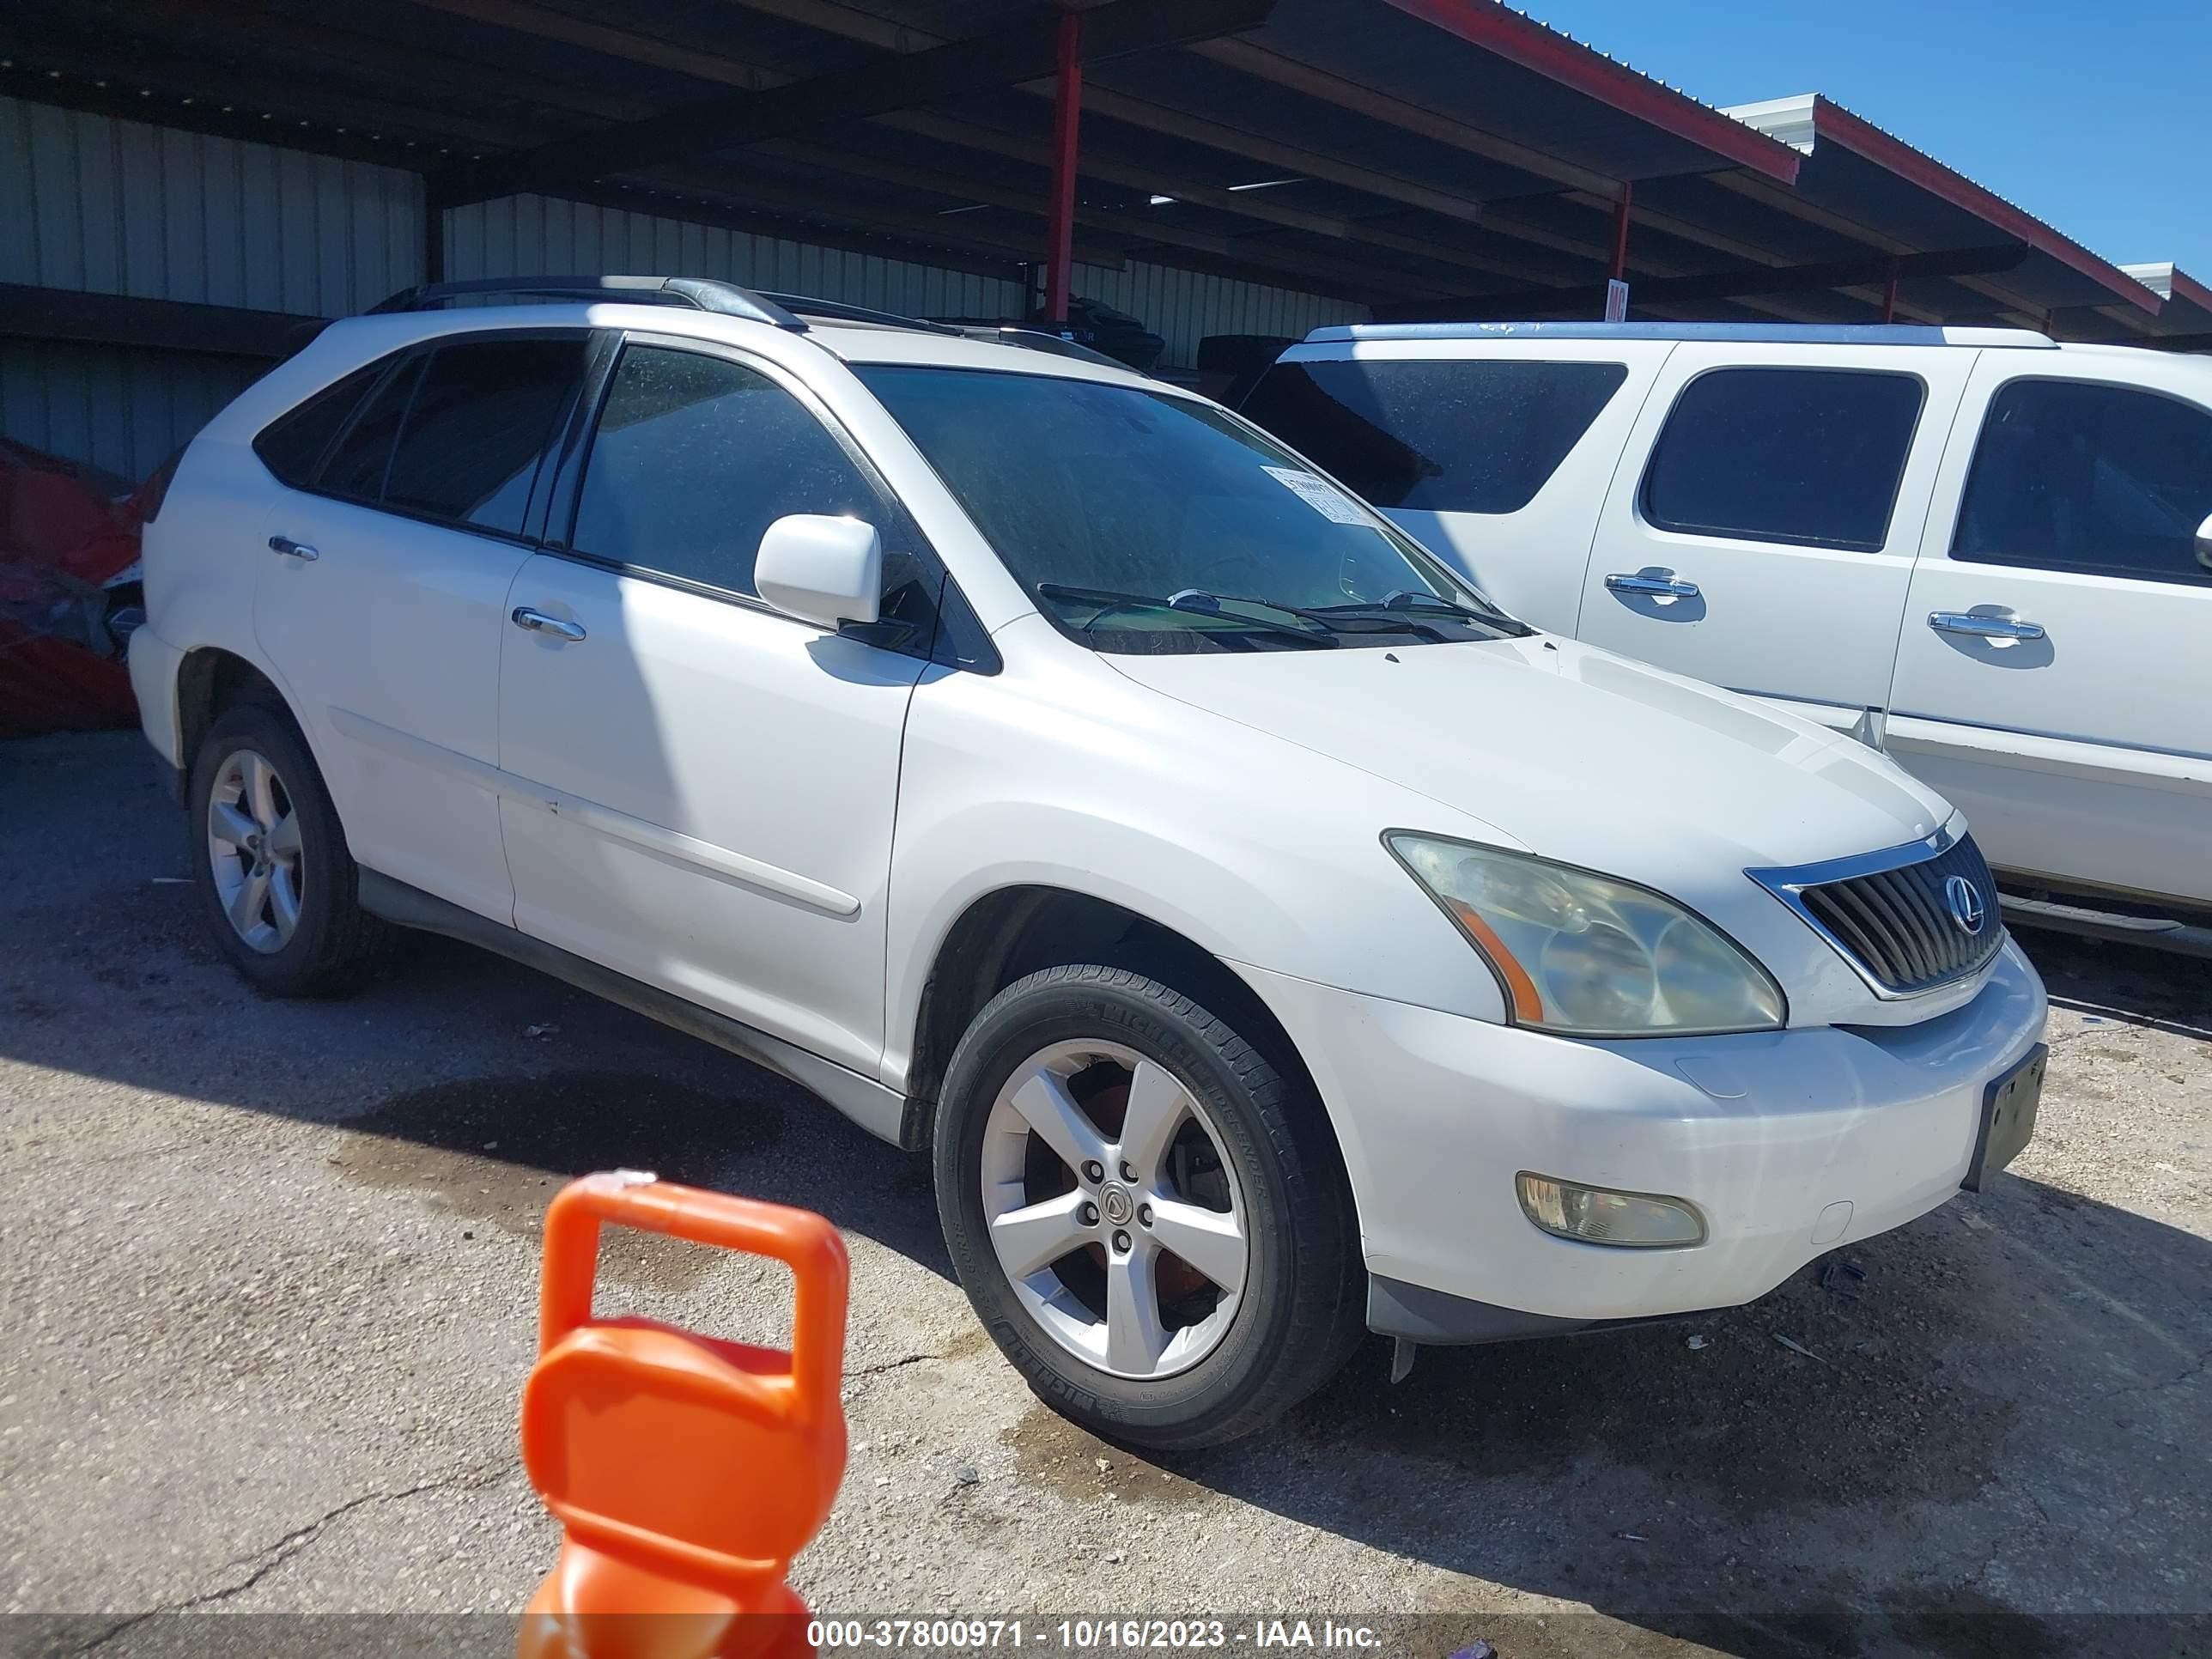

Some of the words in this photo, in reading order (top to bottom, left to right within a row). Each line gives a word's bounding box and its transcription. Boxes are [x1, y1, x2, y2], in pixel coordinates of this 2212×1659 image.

[1102, 1003, 1211, 1085] MICHELIN
[1213, 1094, 1269, 1200] DEFENDER
[994, 1324, 1098, 1413] MICHELIN
